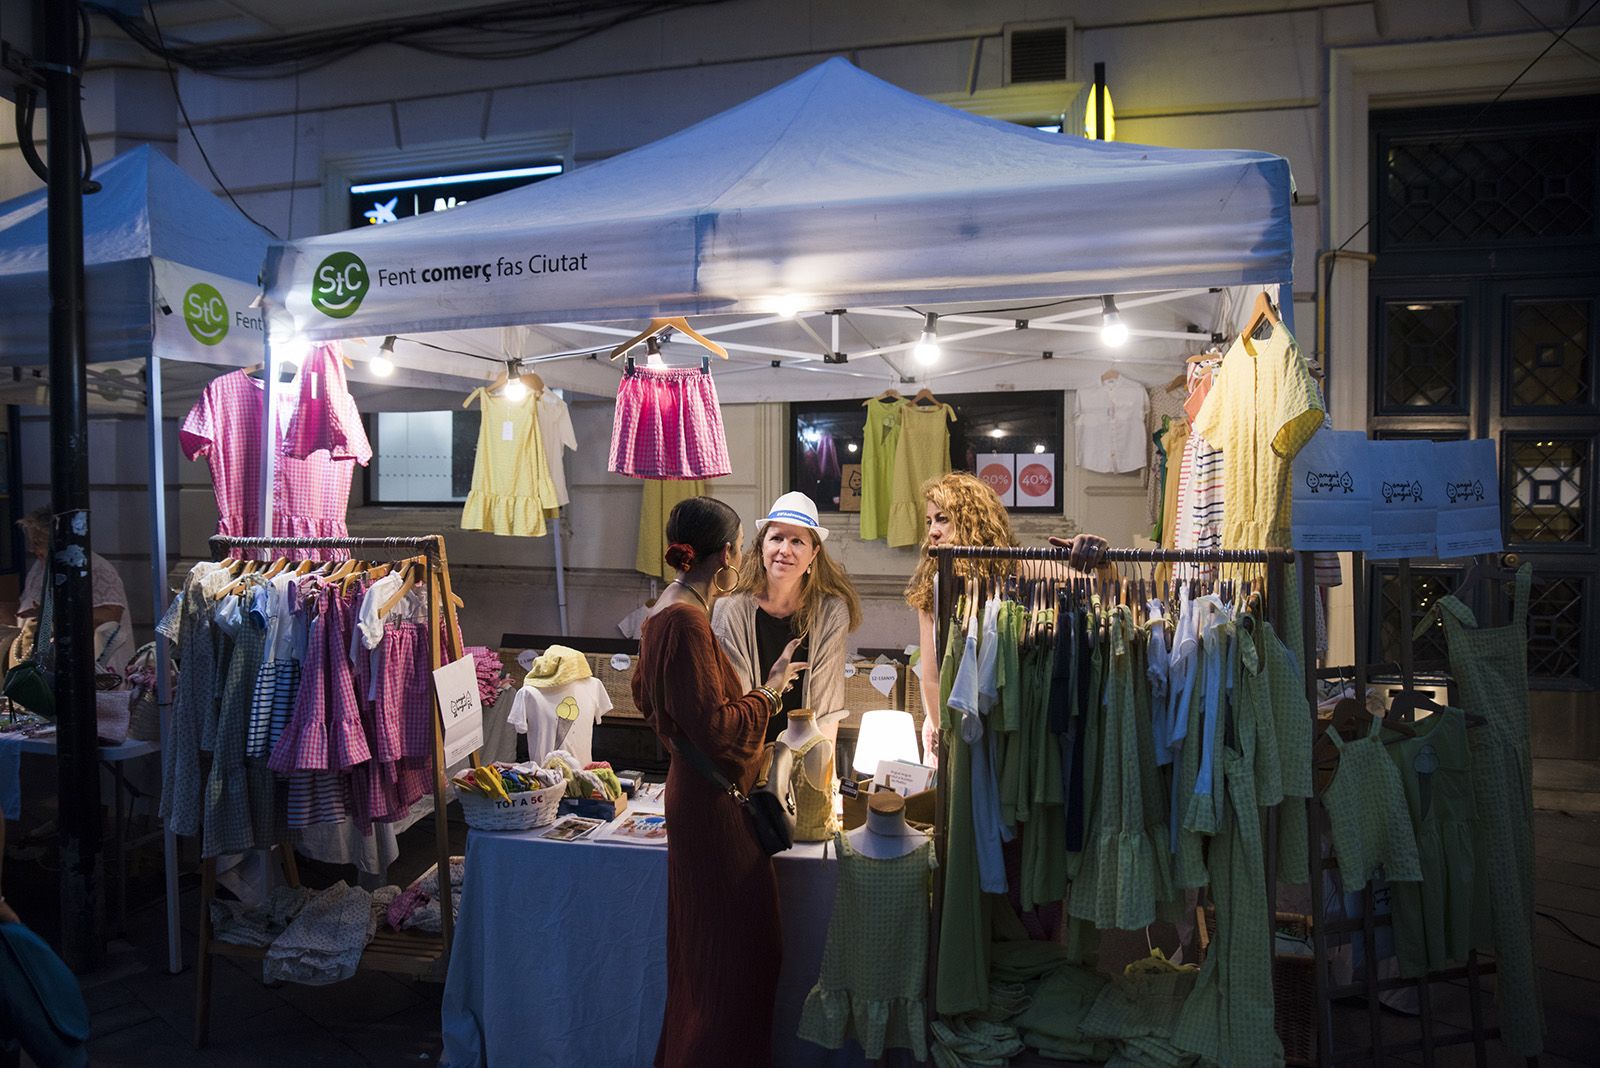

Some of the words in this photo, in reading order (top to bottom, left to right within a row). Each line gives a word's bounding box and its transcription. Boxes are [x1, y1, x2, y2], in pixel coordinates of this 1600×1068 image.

[378, 267, 417, 287] Fent
[421, 262, 491, 282] comerç
[496, 257, 522, 276] fas
[528, 253, 588, 274] Ciutat
[1022, 474, 1049, 486] 40%
[495, 799, 517, 808] TOT
[520, 798, 528, 806] A
[531, 795, 543, 804] 5€
